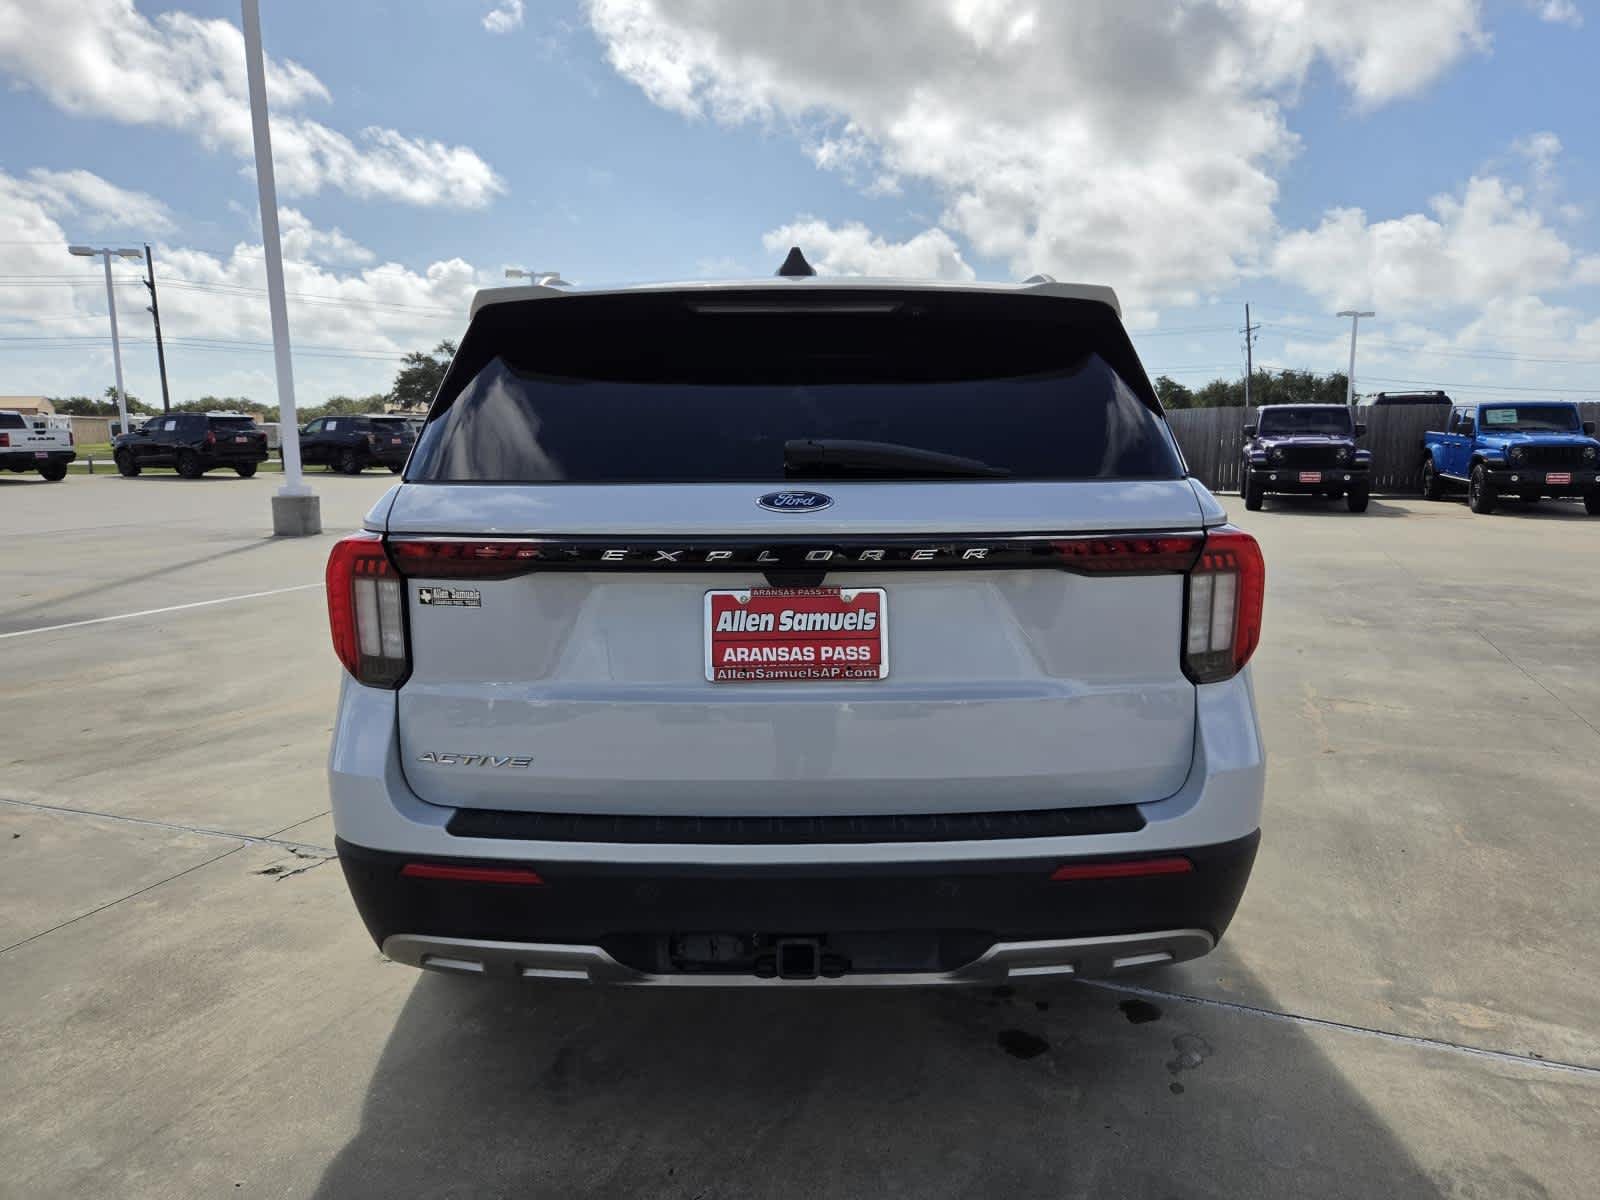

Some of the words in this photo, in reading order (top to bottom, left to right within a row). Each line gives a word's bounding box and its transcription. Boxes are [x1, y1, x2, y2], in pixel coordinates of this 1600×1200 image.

[775, 493, 816, 506] Ford
[601, 548, 990, 562] EXPLORER
[451, 588, 480, 599] Samuels
[716, 610, 775, 632] Allen
[779, 609, 877, 632] Samuels
[723, 647, 815, 662] ARANSAS
[820, 646, 871, 661] PASS
[717, 667, 877, 679] AllenSamuelsAP.com
[417, 752, 533, 768] ACTIVE
